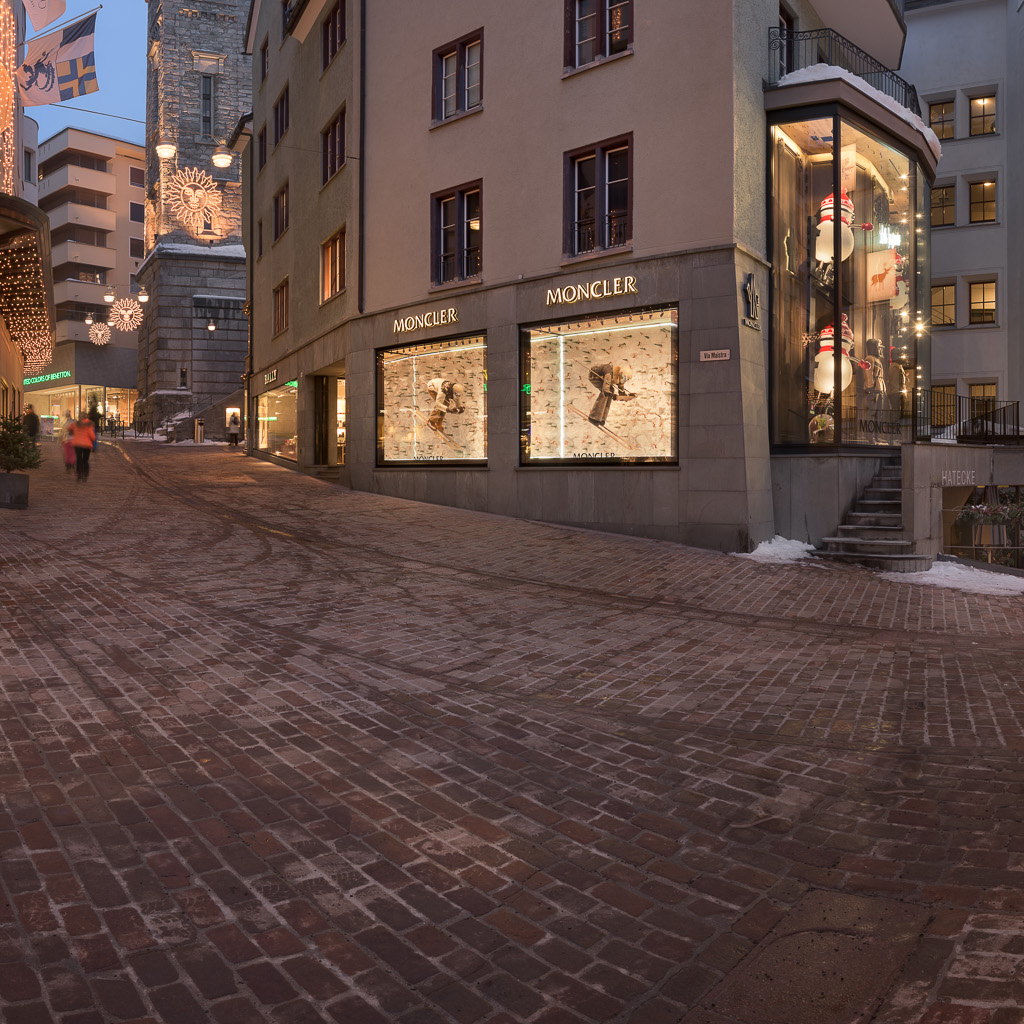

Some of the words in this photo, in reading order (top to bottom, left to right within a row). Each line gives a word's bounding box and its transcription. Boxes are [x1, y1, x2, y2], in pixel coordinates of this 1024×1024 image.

[546, 276, 638, 307] MONCLER
[393, 307, 459, 333] MONCLER
[860, 419, 902, 435] MONCLER
[941, 470, 976, 485] HATECKE
